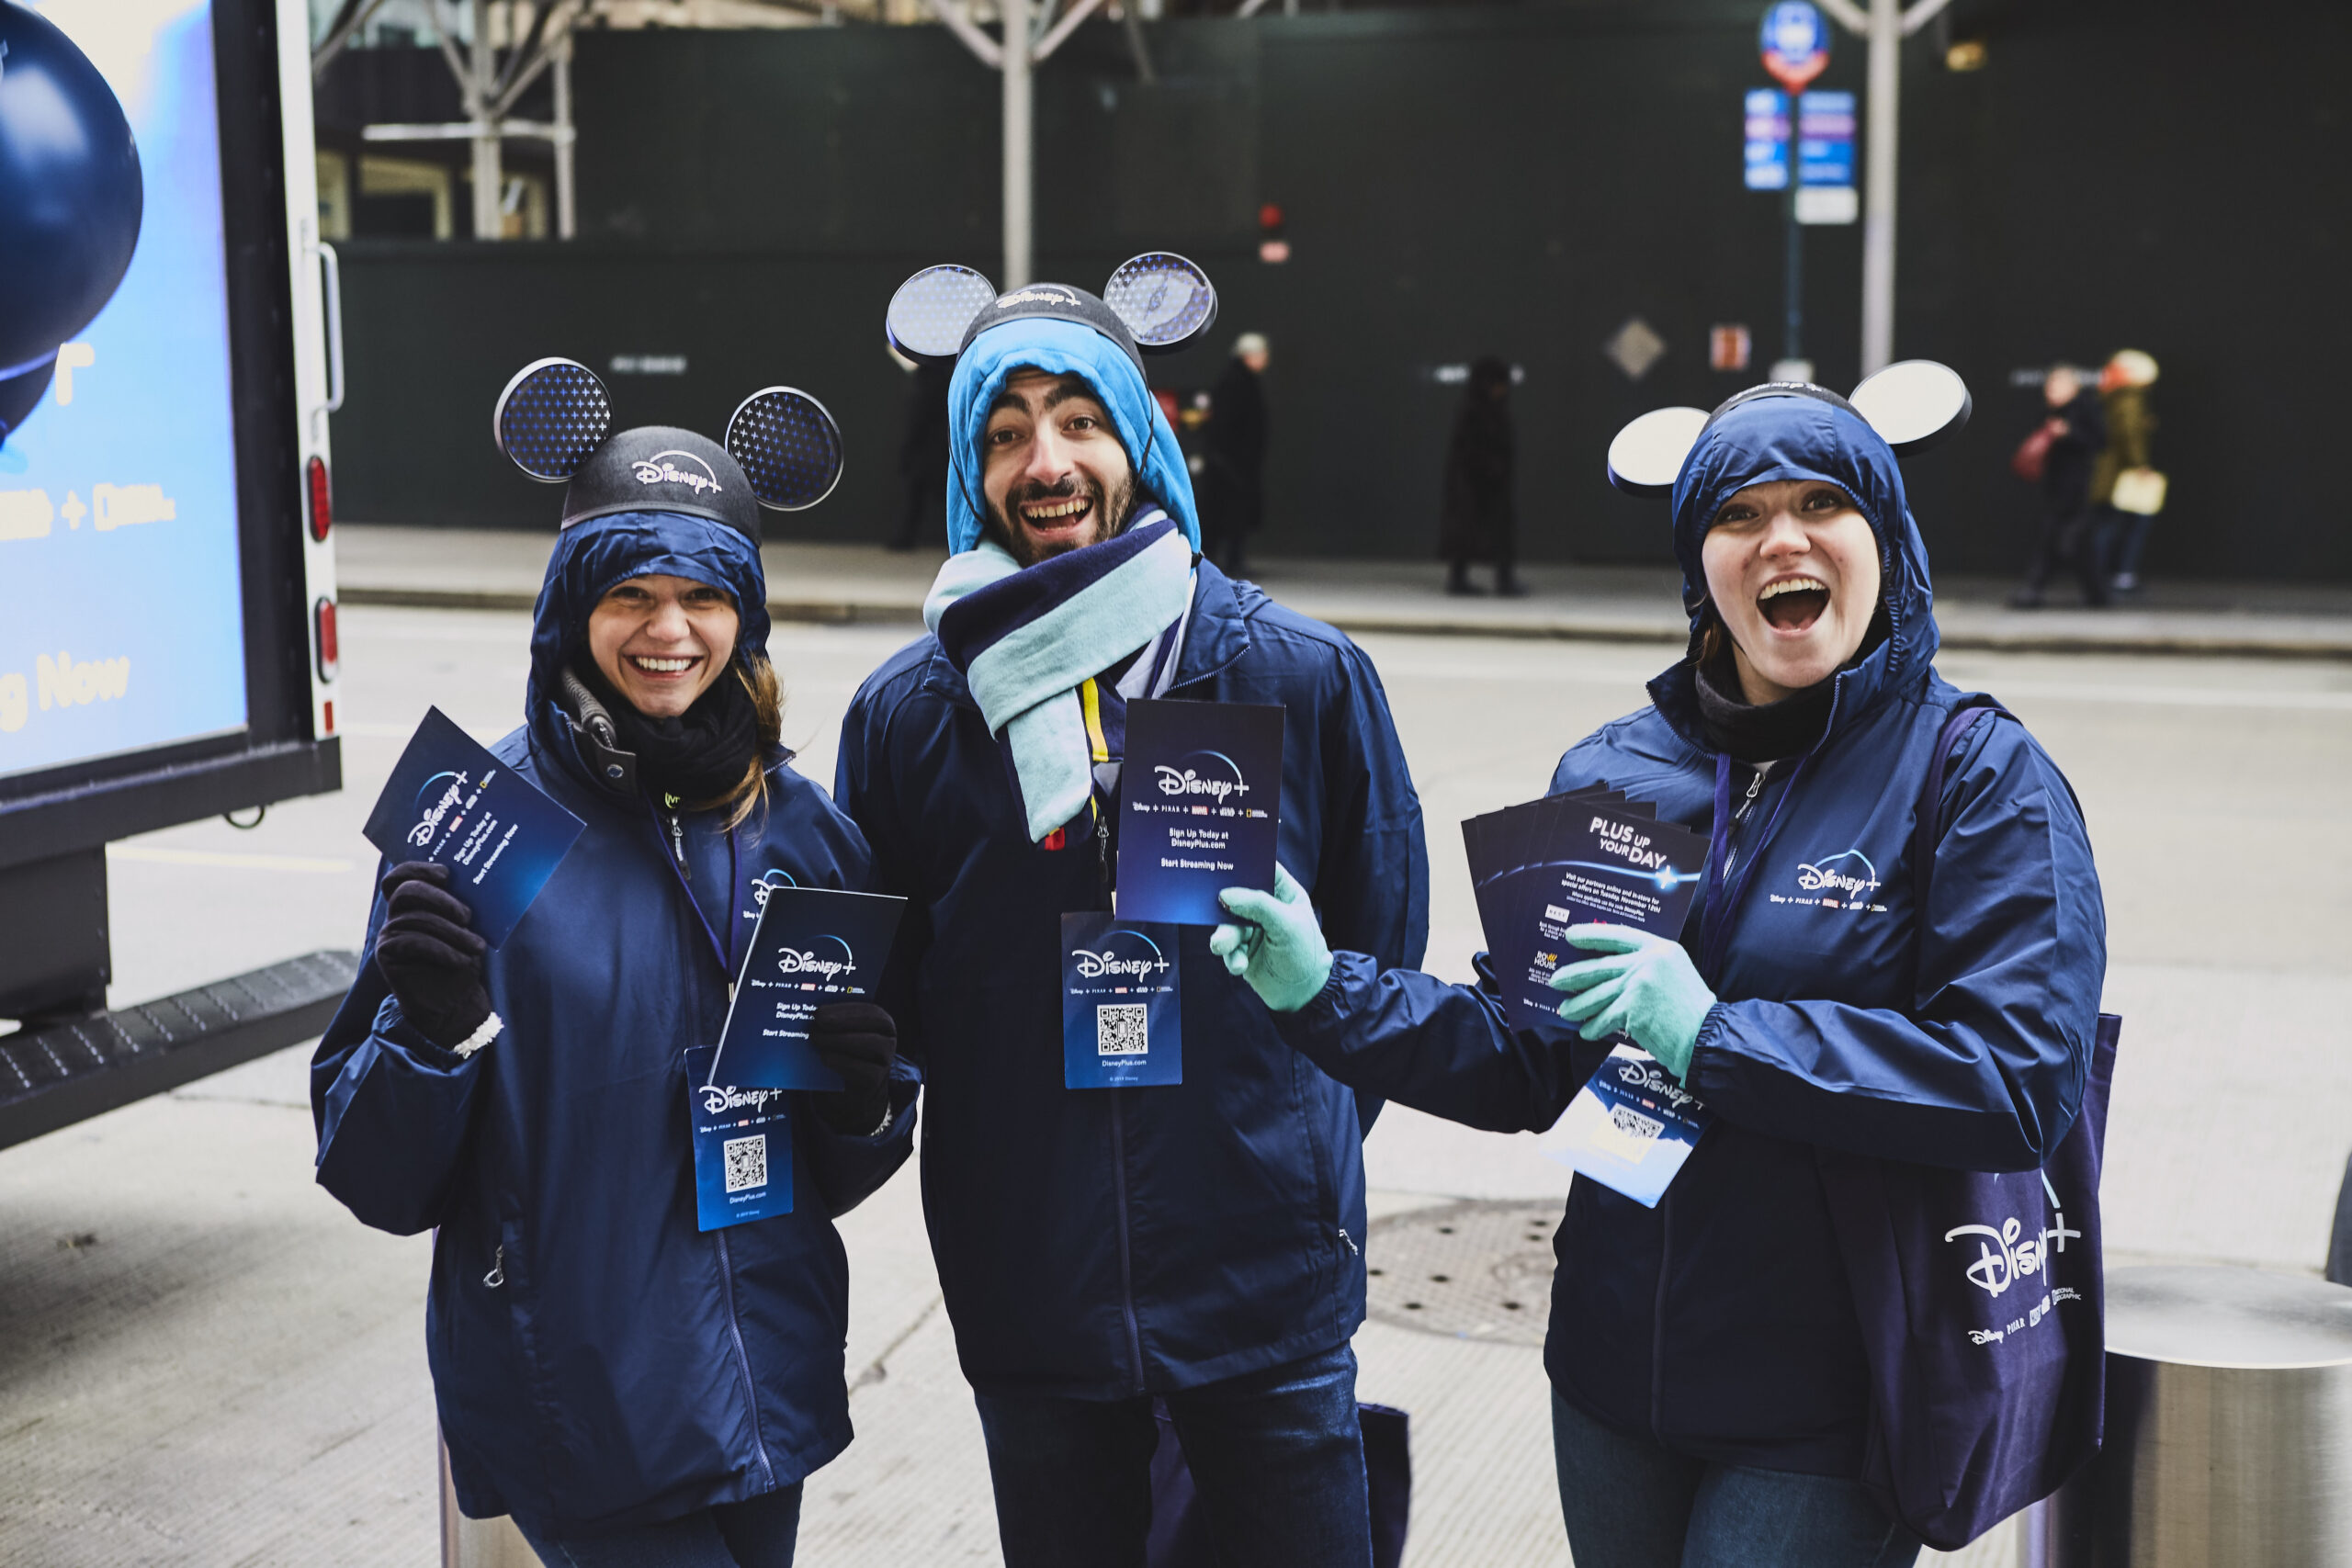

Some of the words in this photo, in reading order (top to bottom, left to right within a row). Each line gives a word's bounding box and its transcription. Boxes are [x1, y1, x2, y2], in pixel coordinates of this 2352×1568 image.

[631, 460, 722, 494] Disney+
[37, 650, 130, 711] Now
[1154, 765, 1250, 804] Disney+
[407, 771, 468, 846] Disney+
[1169, 828, 1184, 839] Sign
[1186, 829, 1197, 839] Up
[1198, 829, 1219, 840] Today
[1221, 830, 1228, 840] at
[1171, 838, 1226, 850] DisneyPlus.com
[1589, 816, 1634, 843] PLUS
[1634, 834, 1651, 849] UP
[1160, 857, 1178, 868] Start
[1180, 858, 1215, 872] Streaming
[1216, 861, 1234, 871] Now
[1600, 837, 1630, 857] YOUR
[1628, 846, 1668, 870] DAY
[1797, 863, 1881, 900] Disney+
[778, 947, 856, 982] Disney+
[1071, 949, 1170, 983] Disney+
[1533, 956, 1556, 970] HOUSE
[775, 1011, 814, 1021] DisneyPlus.c
[776, 1002, 790, 1011] Sign
[791, 1003, 800, 1011] Up
[802, 1003, 817, 1011] Toda
[778, 1030, 808, 1040] Streaming
[1102, 1059, 1147, 1067] DisneyPlus.com
[698, 1085, 782, 1115] Disney+
